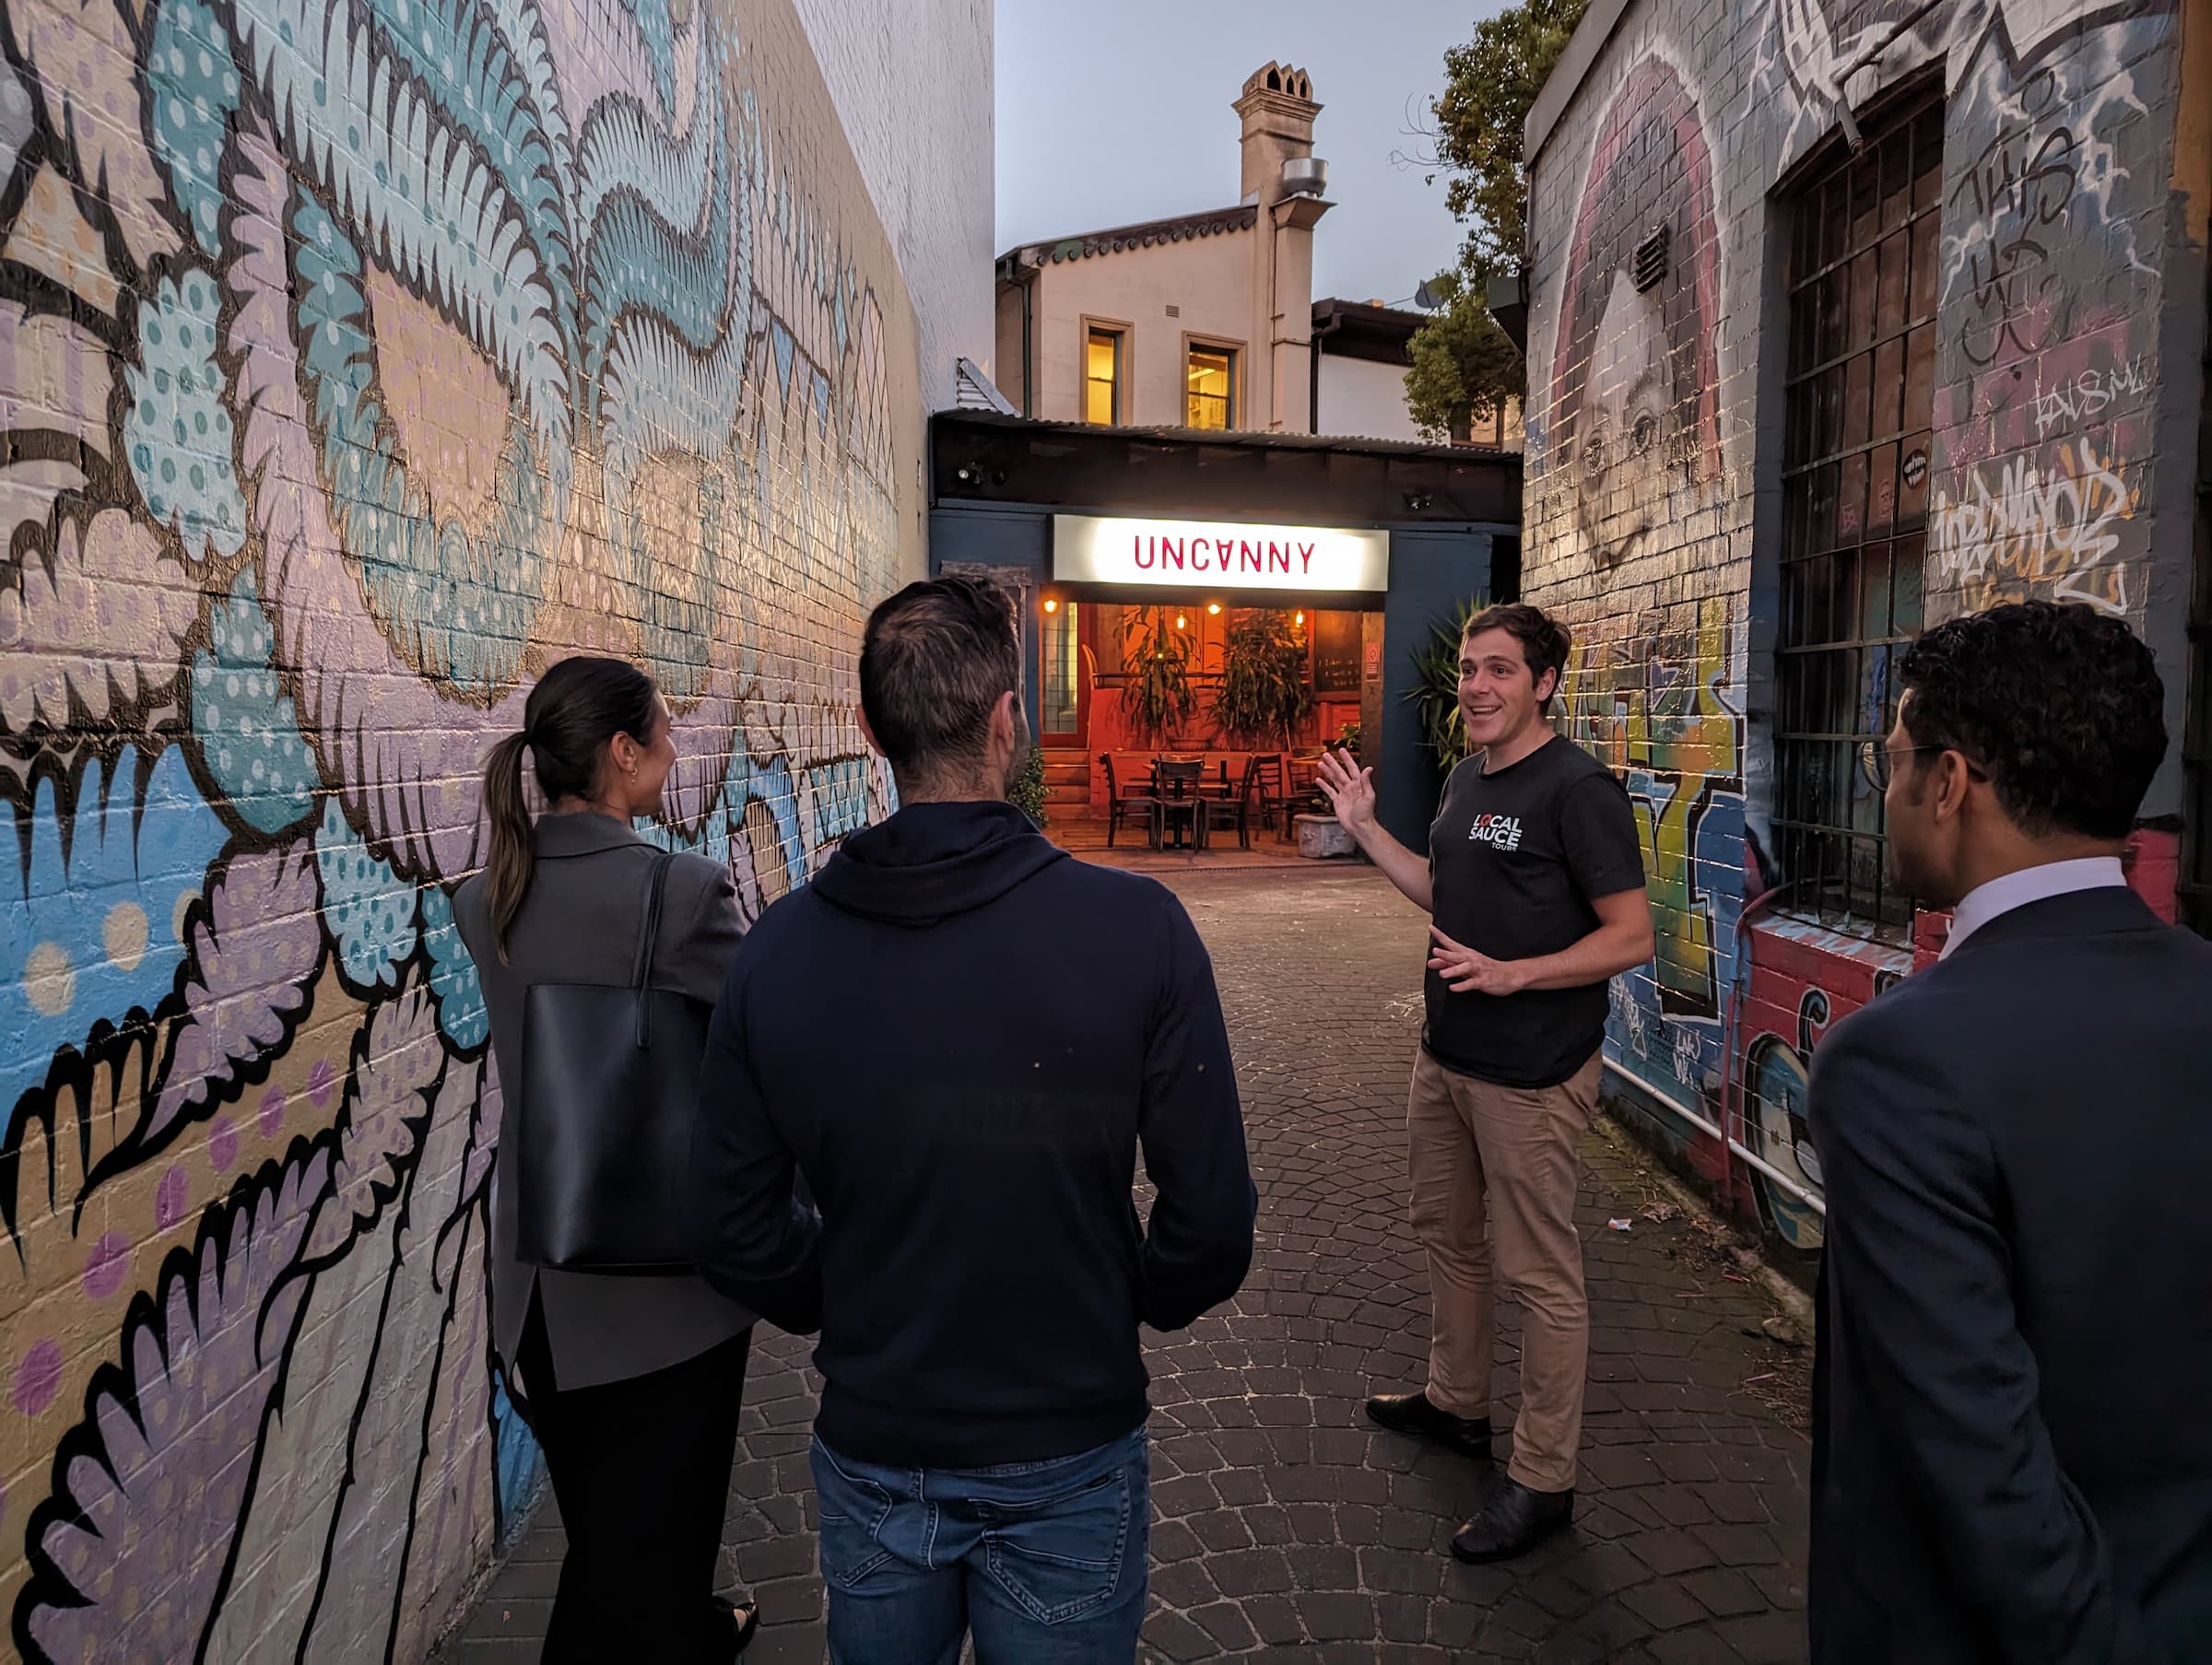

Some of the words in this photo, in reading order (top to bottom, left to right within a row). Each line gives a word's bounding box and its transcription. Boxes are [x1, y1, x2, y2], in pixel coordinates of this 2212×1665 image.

[1135, 535, 1315, 574] UNCANNY
[1473, 814, 1523, 834] LOCAL
[1468, 827, 1522, 847] SAUCE
[1491, 842, 1517, 851] TOURS
